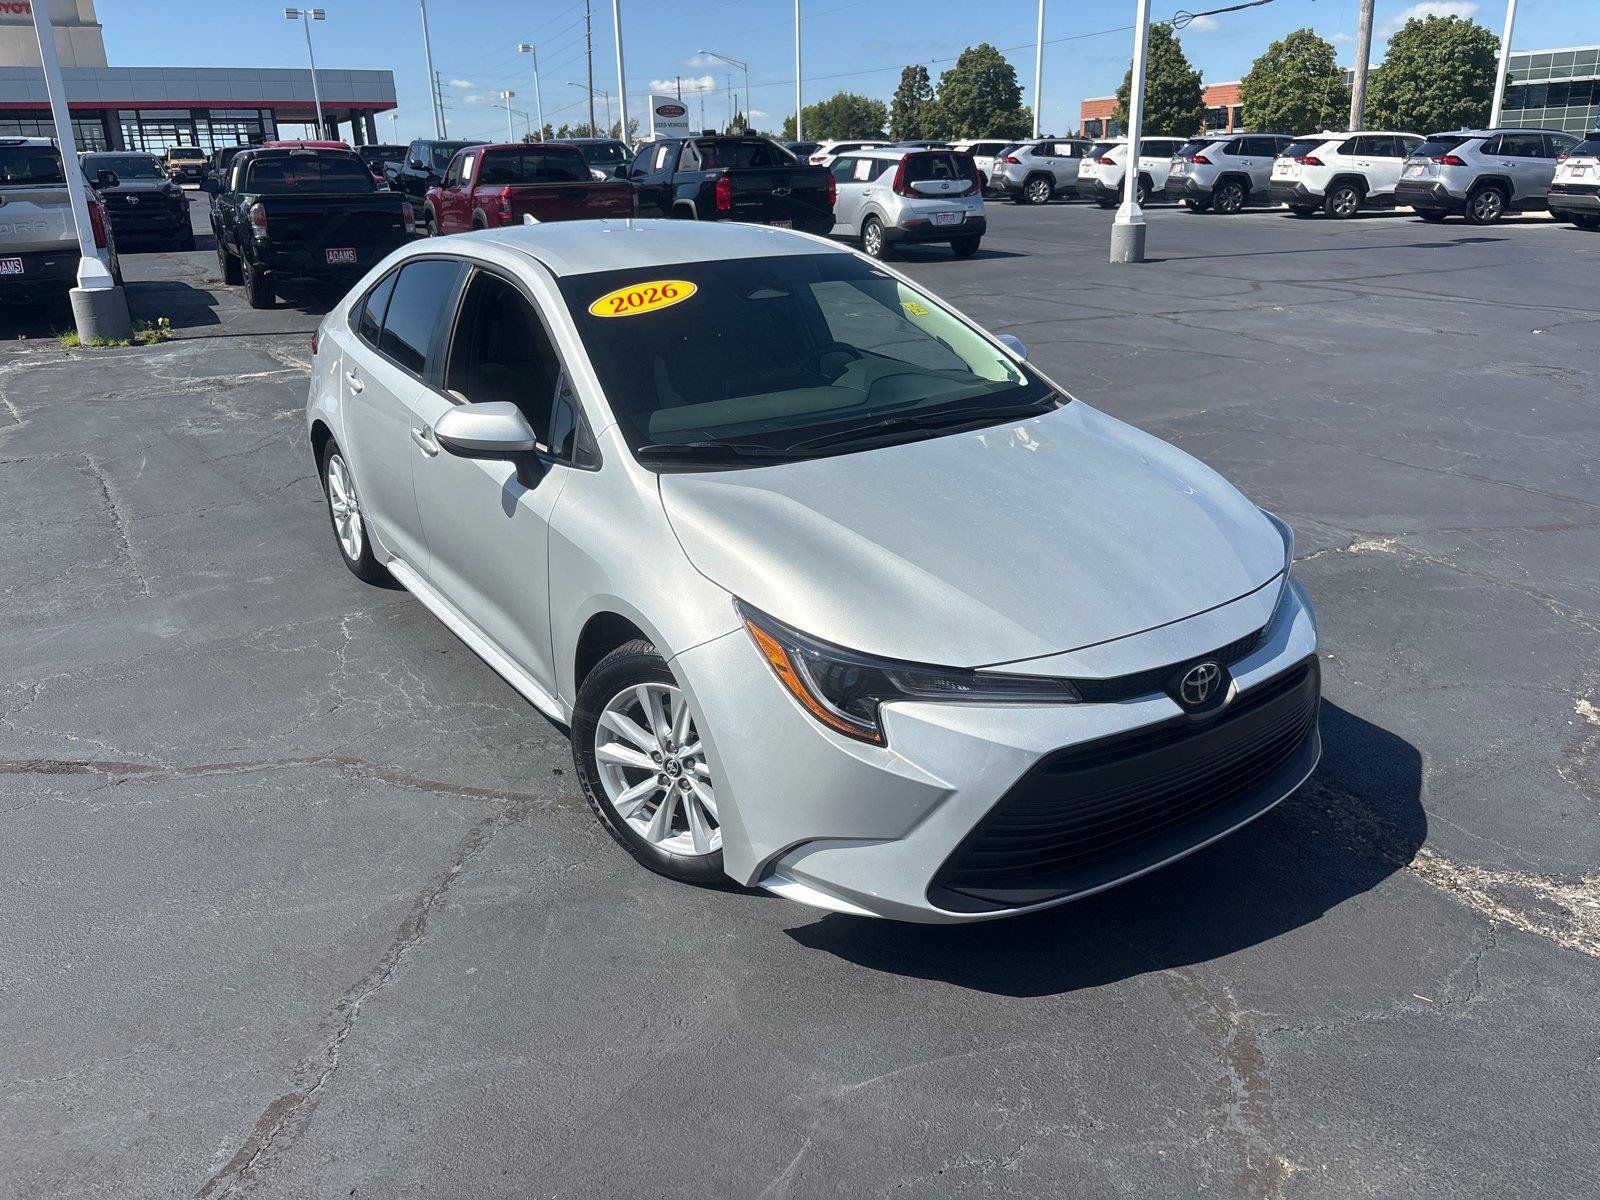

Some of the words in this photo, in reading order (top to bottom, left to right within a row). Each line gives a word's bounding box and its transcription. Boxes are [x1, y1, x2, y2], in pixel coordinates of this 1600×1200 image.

[328, 250, 354, 261] ADAMS
[0, 260, 20, 273] AMS
[609, 283, 678, 314] 2026
